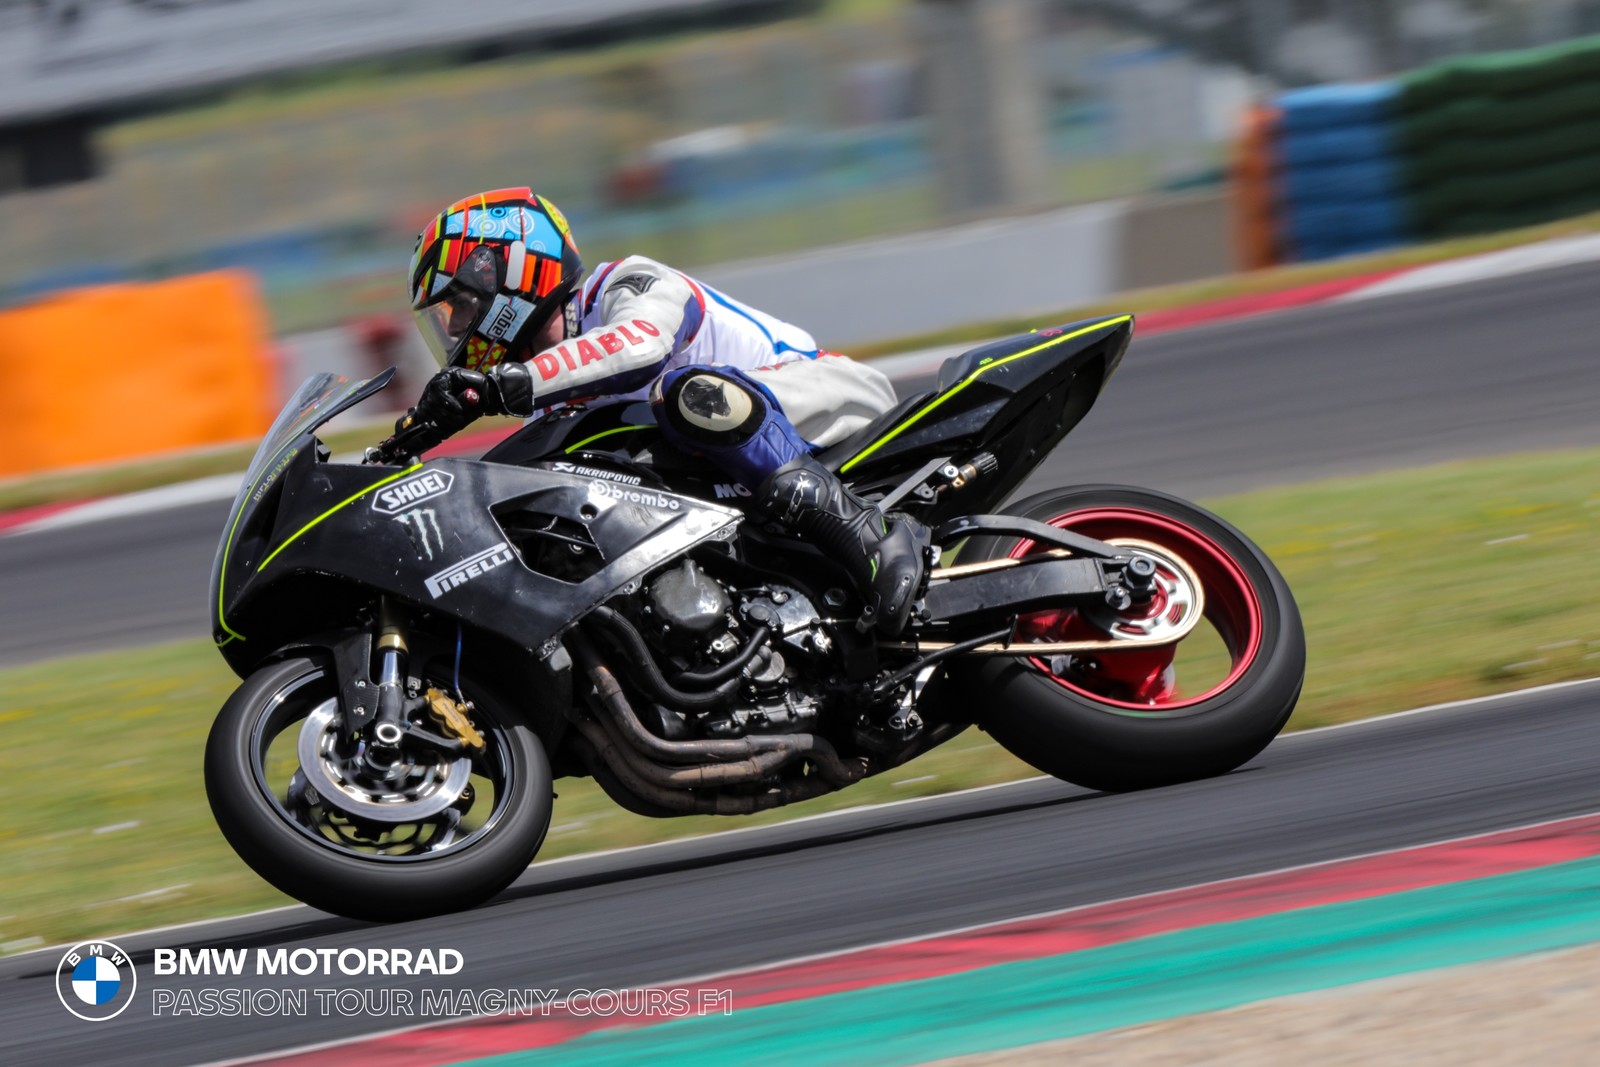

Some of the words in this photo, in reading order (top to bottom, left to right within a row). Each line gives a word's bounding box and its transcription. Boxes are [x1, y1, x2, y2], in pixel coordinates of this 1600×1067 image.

[491, 308, 514, 337] agv
[532, 319, 660, 381] DIABLO
[380, 473, 446, 510] SHOEI
[575, 467, 641, 486] AKRAPOVIC
[611, 485, 680, 510] brembo
[424, 542, 514, 600] PIRELLI
